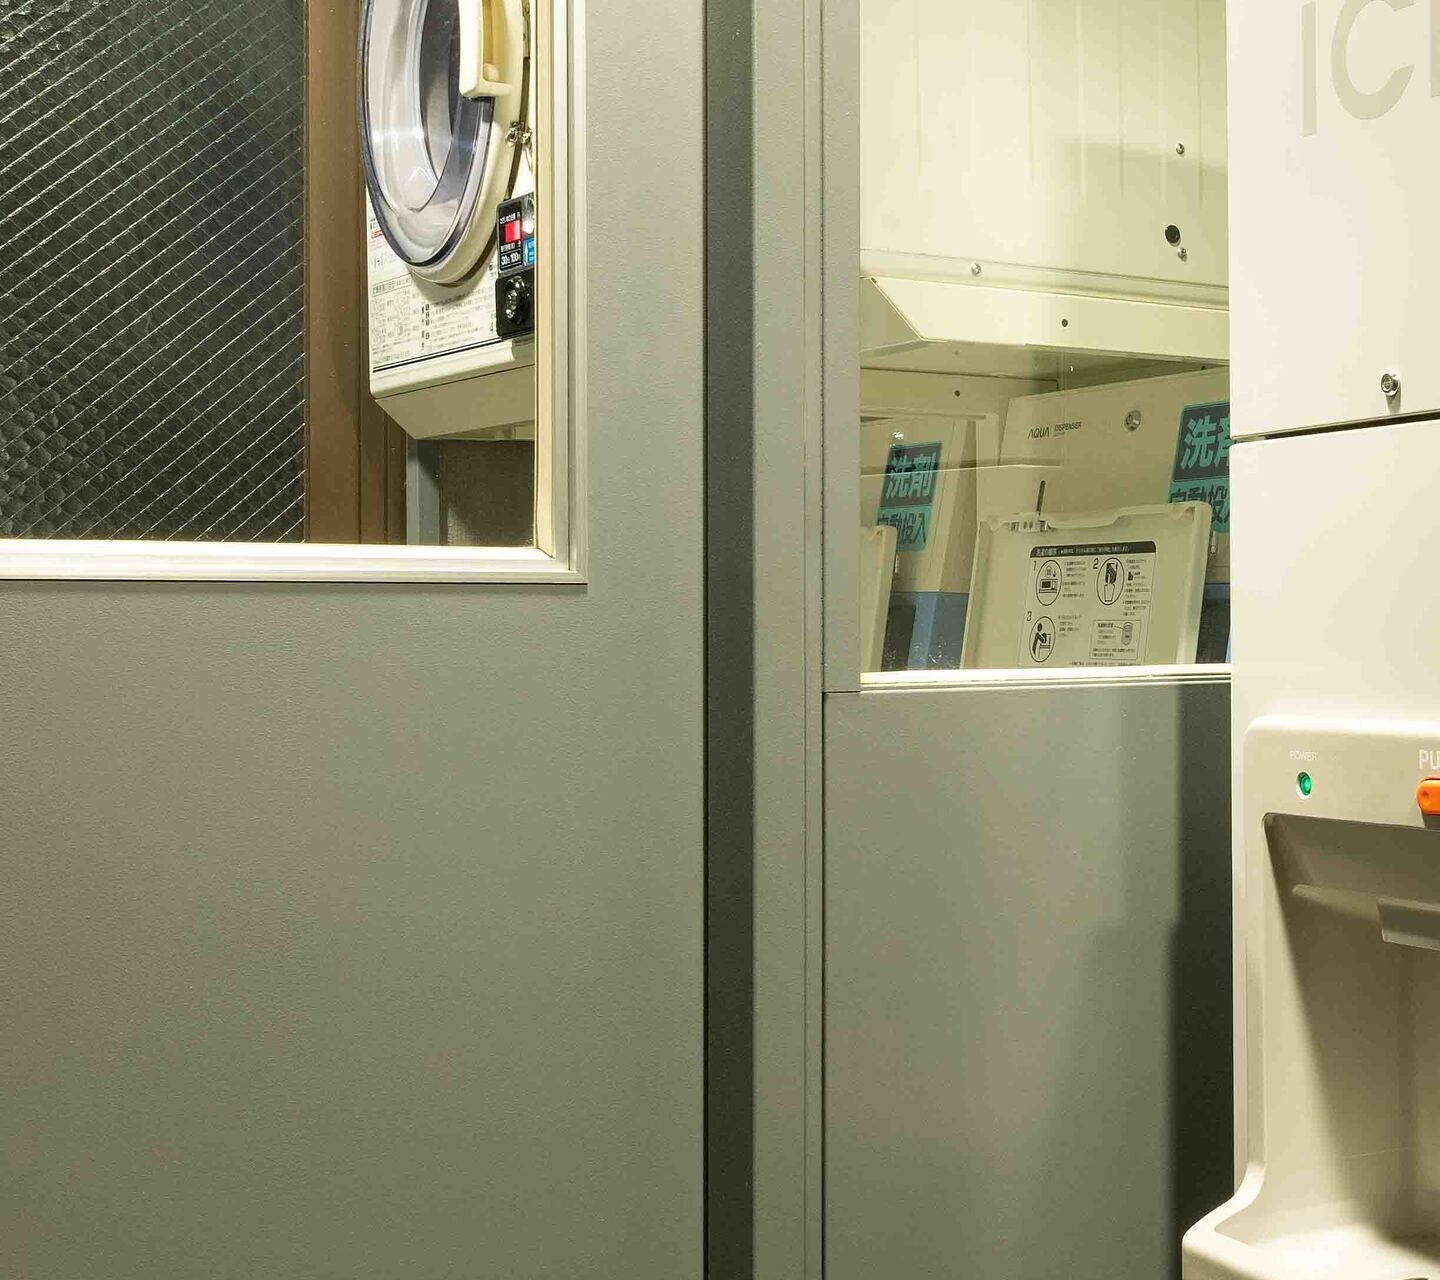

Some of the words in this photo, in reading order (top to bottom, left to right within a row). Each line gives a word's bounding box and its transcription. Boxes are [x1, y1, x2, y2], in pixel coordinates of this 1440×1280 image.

[1027, 426, 1050, 440] AQUA
[886, 452, 937, 499] 洗剤
[1289, 750, 1318, 761] POWER
